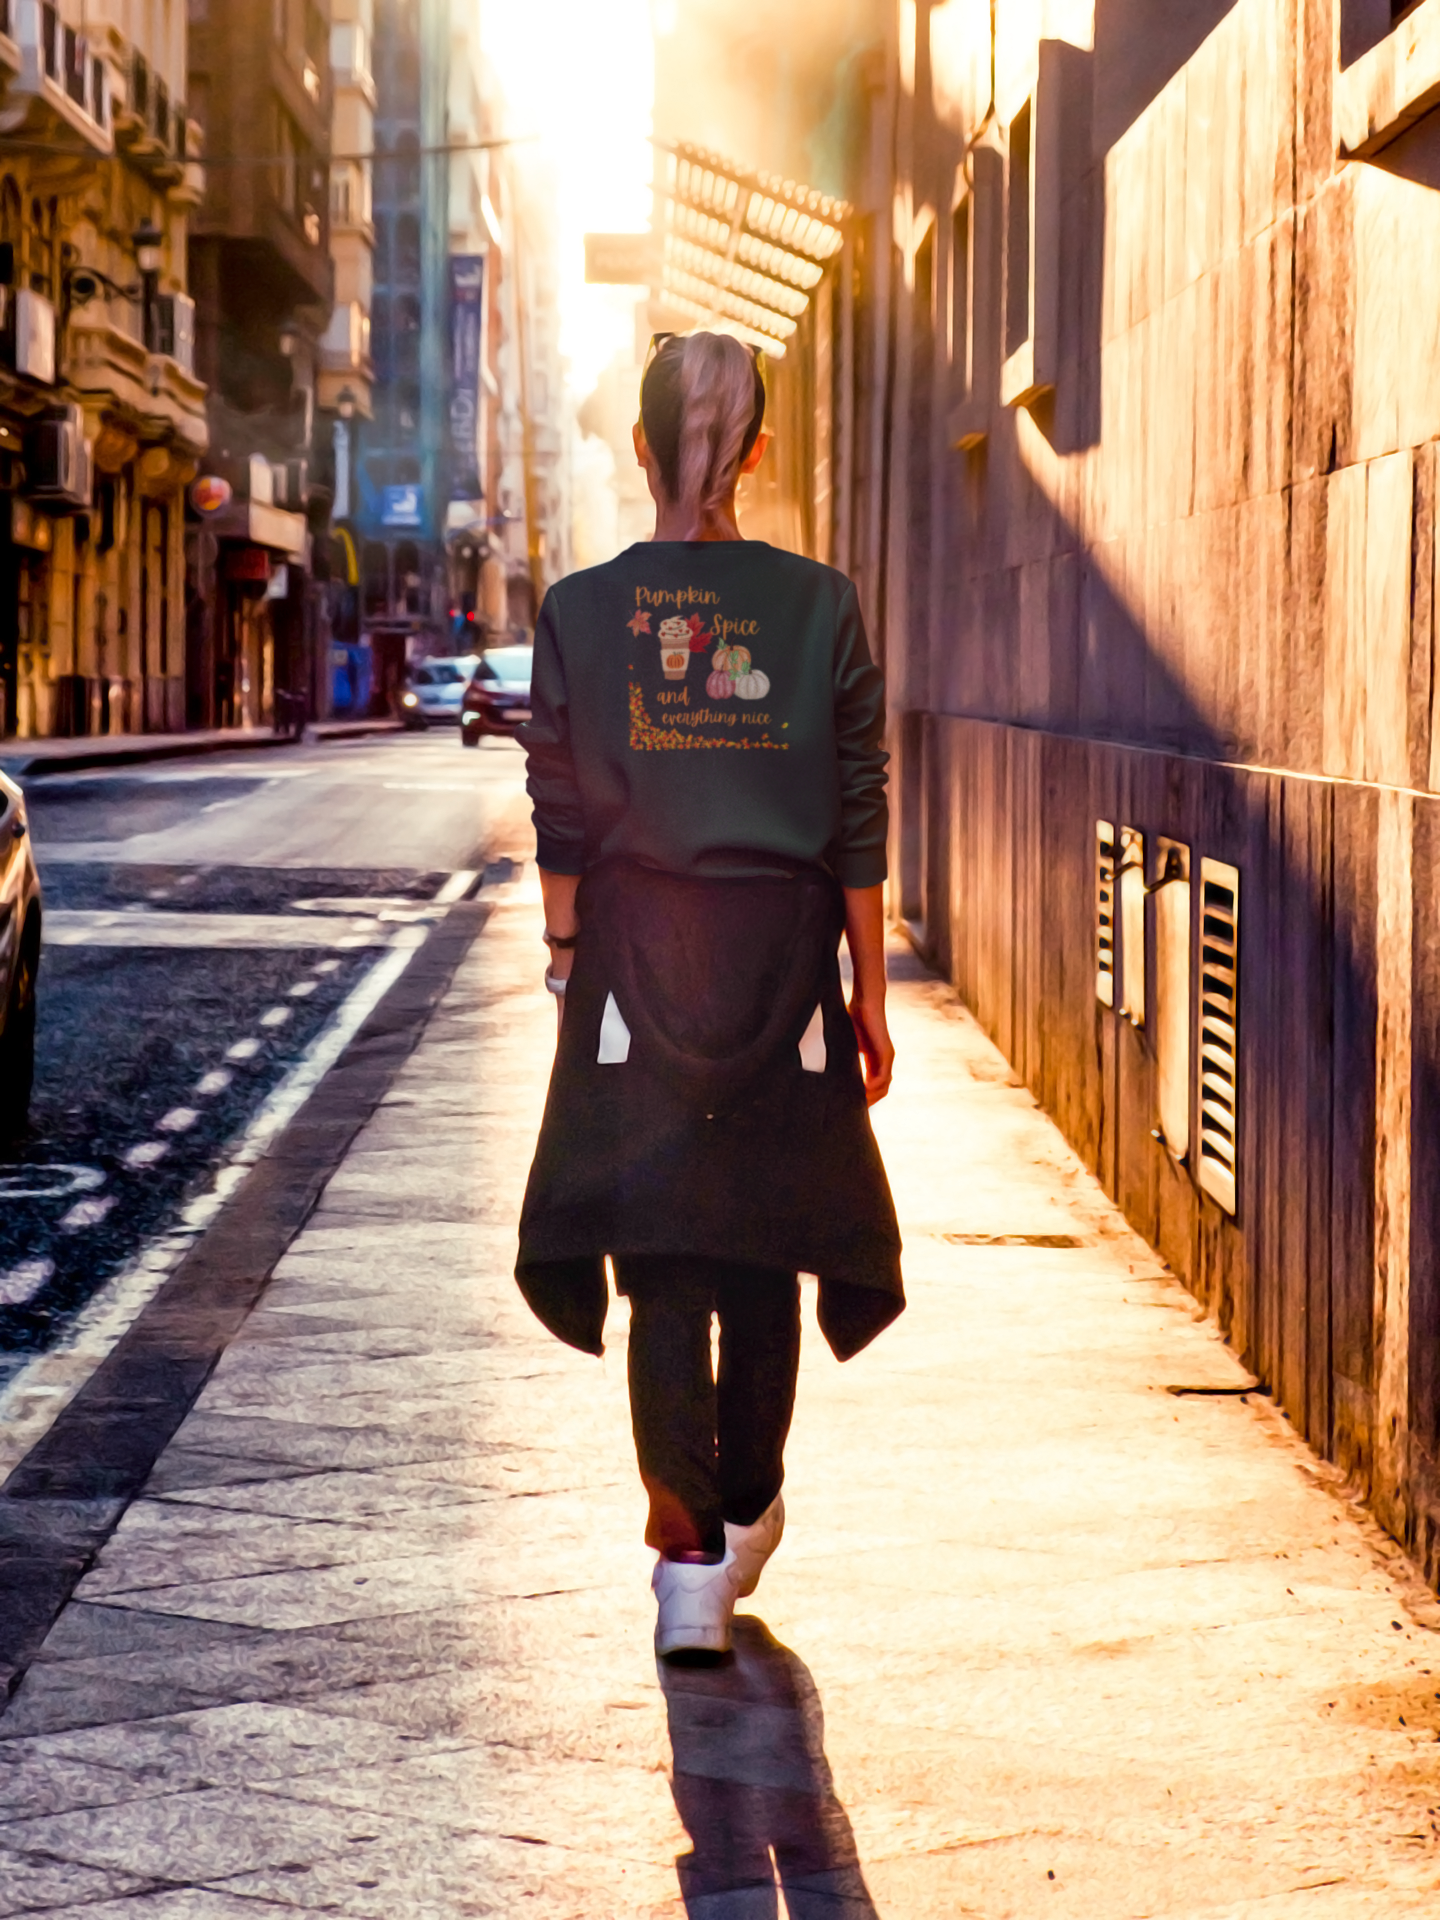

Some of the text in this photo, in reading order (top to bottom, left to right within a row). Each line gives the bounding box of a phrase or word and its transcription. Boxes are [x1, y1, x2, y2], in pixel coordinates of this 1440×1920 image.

[635, 585, 720, 609] Pumpkin
[710, 613, 760, 640] Spice
[657, 686, 690, 706] and
[661, 708, 772, 727] everything nice
